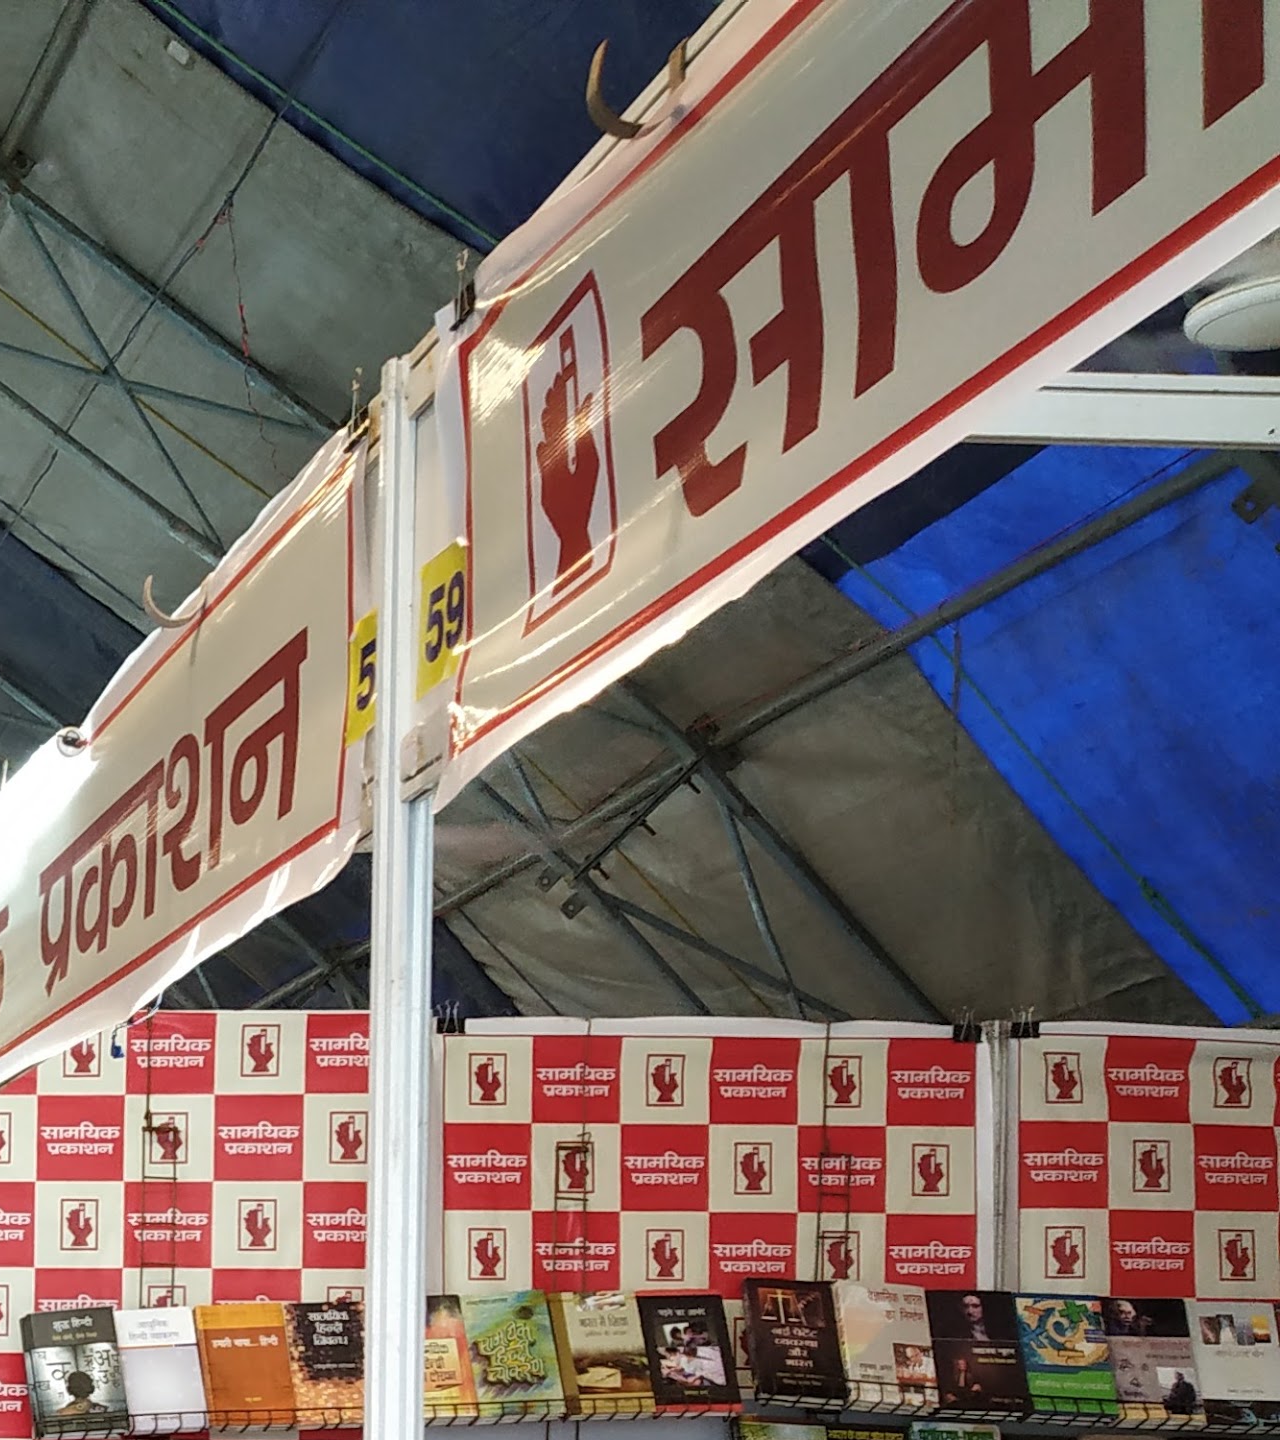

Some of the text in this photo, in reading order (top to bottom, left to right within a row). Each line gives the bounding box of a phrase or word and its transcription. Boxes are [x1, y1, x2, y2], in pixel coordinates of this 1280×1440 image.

[423, 569, 465, 666] 59
[356, 643, 377, 711] 5
[40, 627, 309, 995] प्रकाशन
[130, 1033, 212, 1053] सामयिक
[136, 1055, 205, 1069] प्रकाशन
[536, 1062, 616, 1081] सामयिक
[714, 1064, 794, 1083] सामयिक
[890, 1065, 971, 1084] सामयिक
[1110, 1063, 1185, 1082] सामयिक
[542, 1084, 610, 1097] प्रकाशन
[719, 1085, 787, 1098] प्रकाशन
[897, 1087, 965, 1099] प्रकाशन
[1115, 1085, 1180, 1098] प्रकाशन
[40, 1121, 121, 1140] सामयिक
[217, 1120, 300, 1140] सामयिक
[46, 1142, 114, 1155] प्रकाशन
[224, 1142, 293, 1155] प्रकाशन
[1023, 1147, 1104, 1166] सामयिक
[447, 1149, 528, 1168] सामयिक
[624, 1150, 706, 1169] सामयिक
[1198, 1151, 1274, 1170] सामयिक
[453, 1171, 522, 1184] प्रकाशन
[630, 1172, 700, 1185] प्रकाशन
[1029, 1169, 1099, 1182] प्रकाशन
[1204, 1172, 1268, 1185] प्रकाशन
[712, 1238, 793, 1258] सामयिक
[888, 1240, 973, 1259] सामयिक
[1112, 1236, 1191, 1255] सामयिक
[719, 1260, 786, 1273] प्रकाशन
[895, 1262, 966, 1275] प्रकाशन
[1119, 1258, 1185, 1271] प्रकाशन
